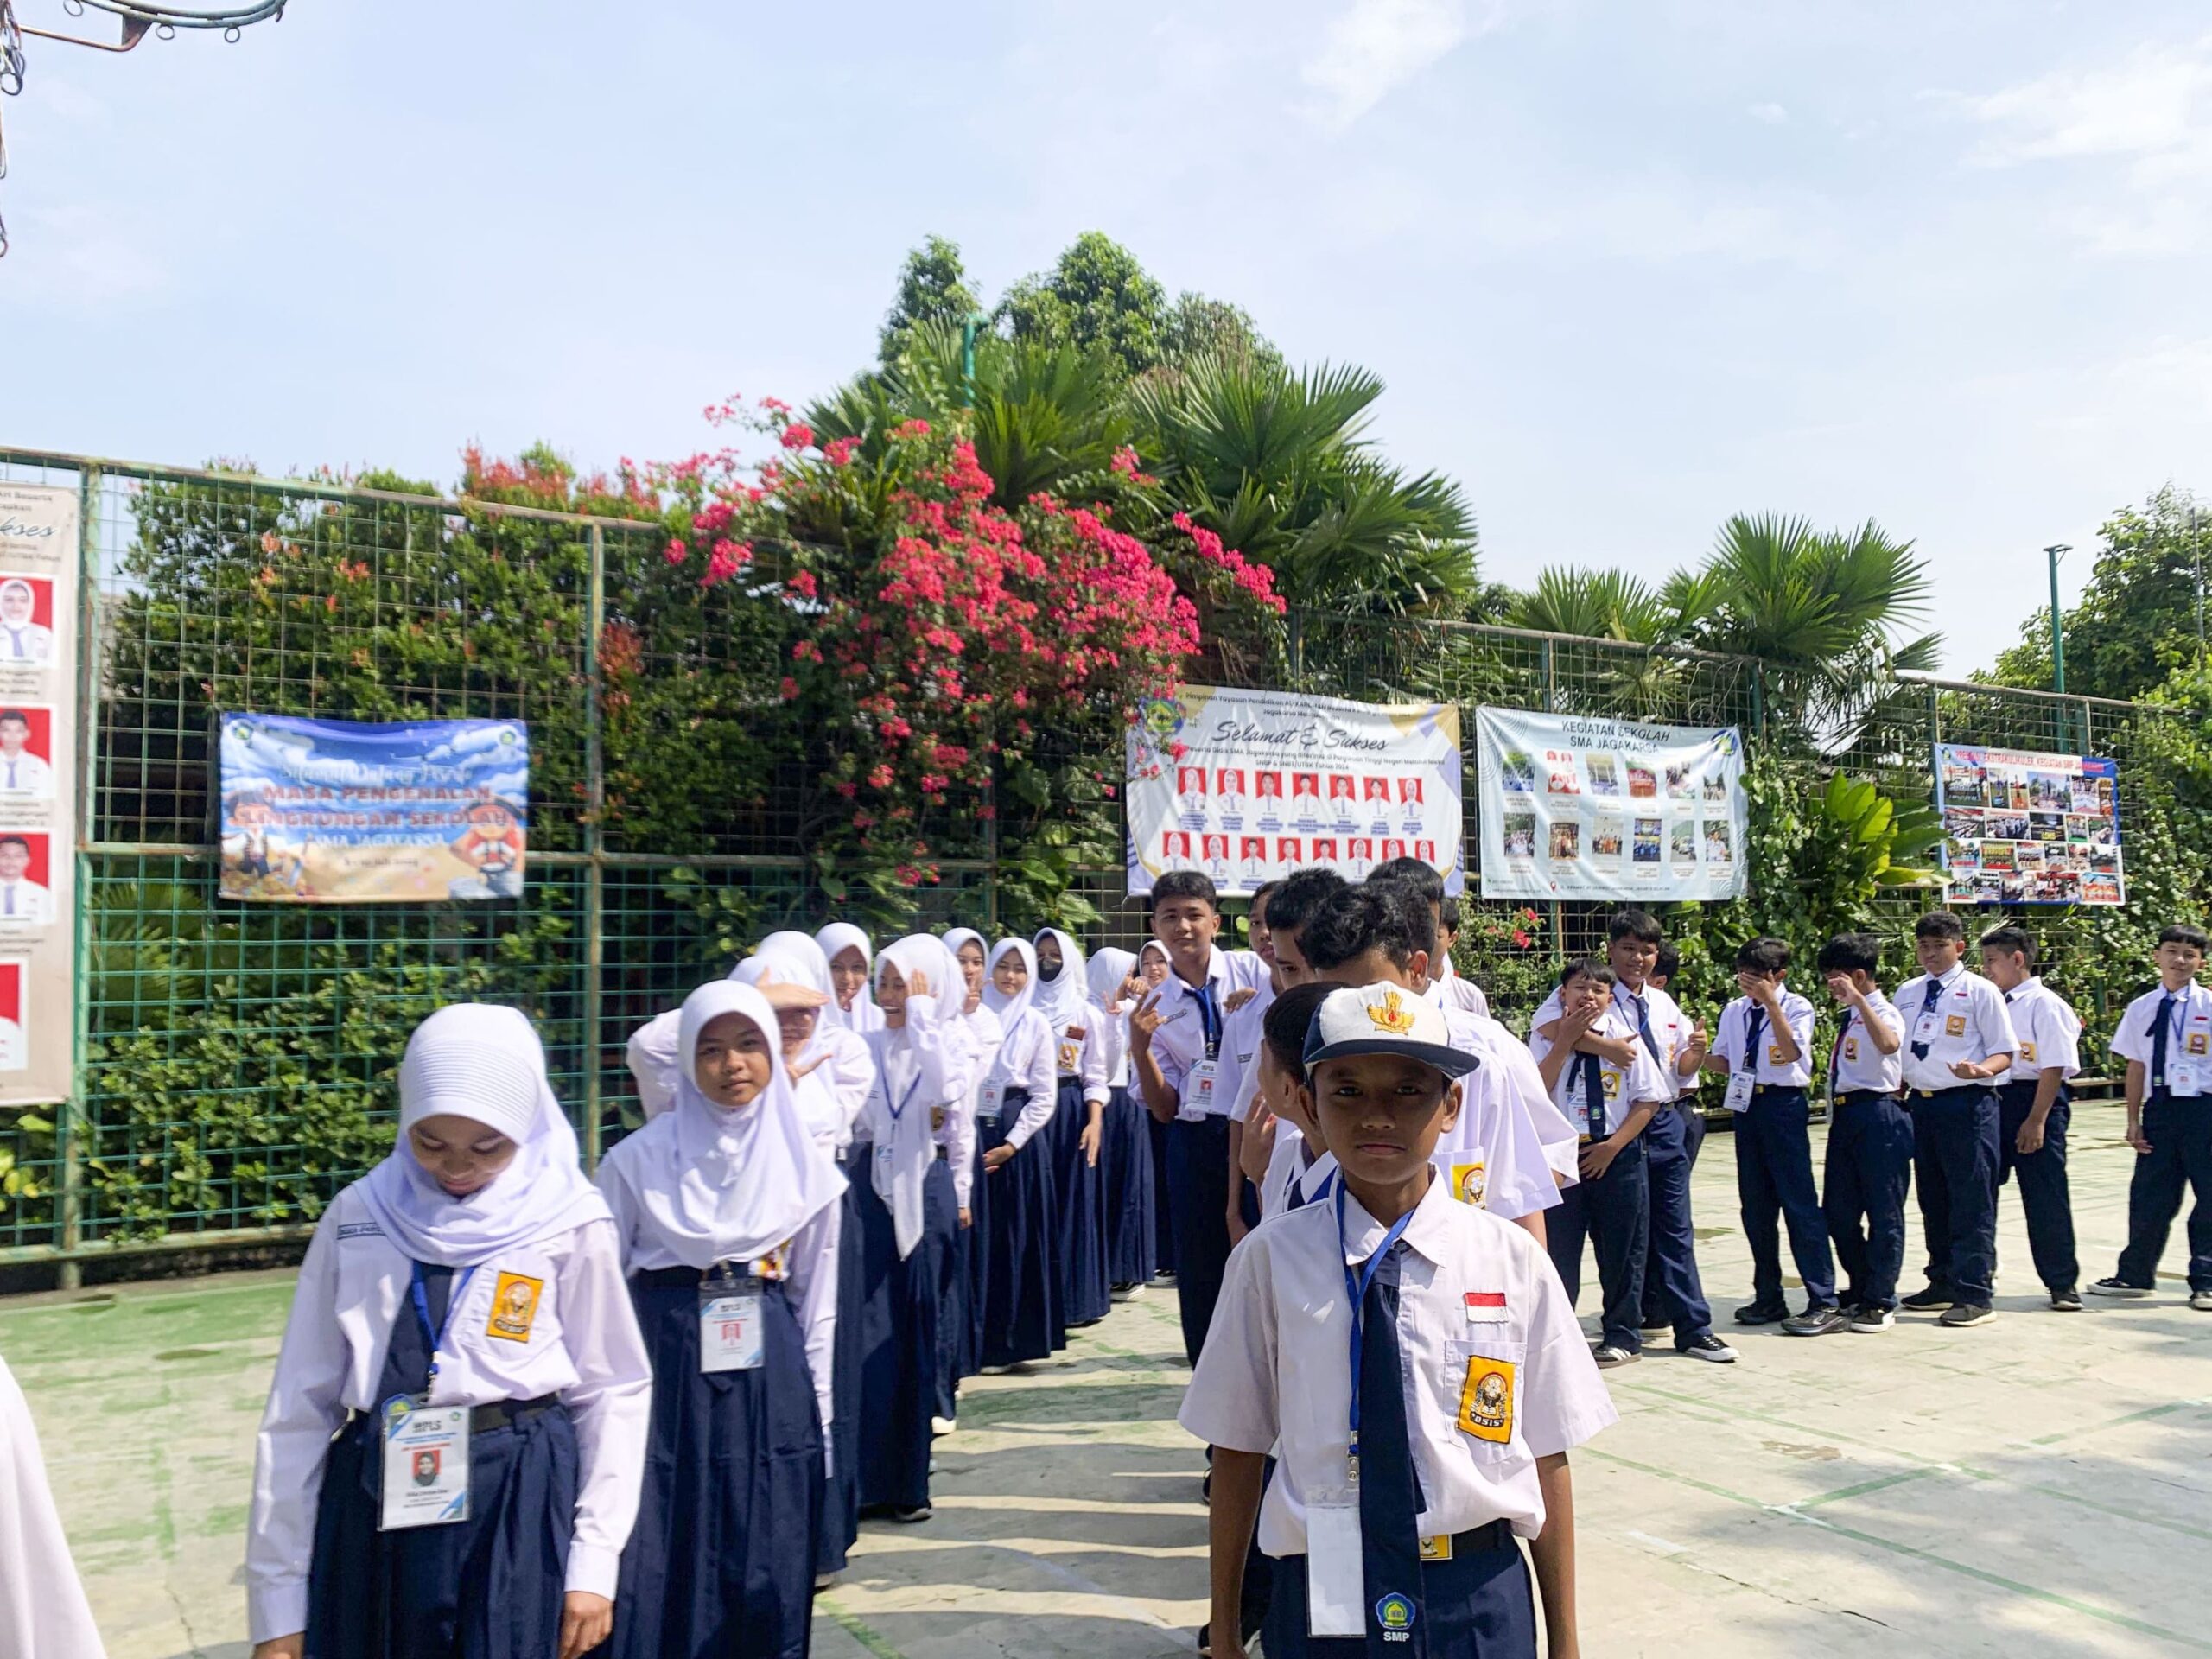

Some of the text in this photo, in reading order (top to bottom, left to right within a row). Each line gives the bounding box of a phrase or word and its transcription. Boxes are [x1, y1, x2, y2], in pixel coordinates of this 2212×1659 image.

[1185, 691, 1217, 702] Pimpinan
[1212, 721, 1389, 751] Selamat & Sukses
[1562, 721, 1670, 742] KEGIATAN SEKOLAH
[1570, 735, 1660, 754] SMA JAGAKARSA
[263, 785, 491, 801] MASA PENGENALAN
[245, 809, 508, 827] LINGKUNGAN SEKOLAH
[1474, 1416, 1502, 1427] OSIS
[1383, 1631, 1410, 1642] SMP
